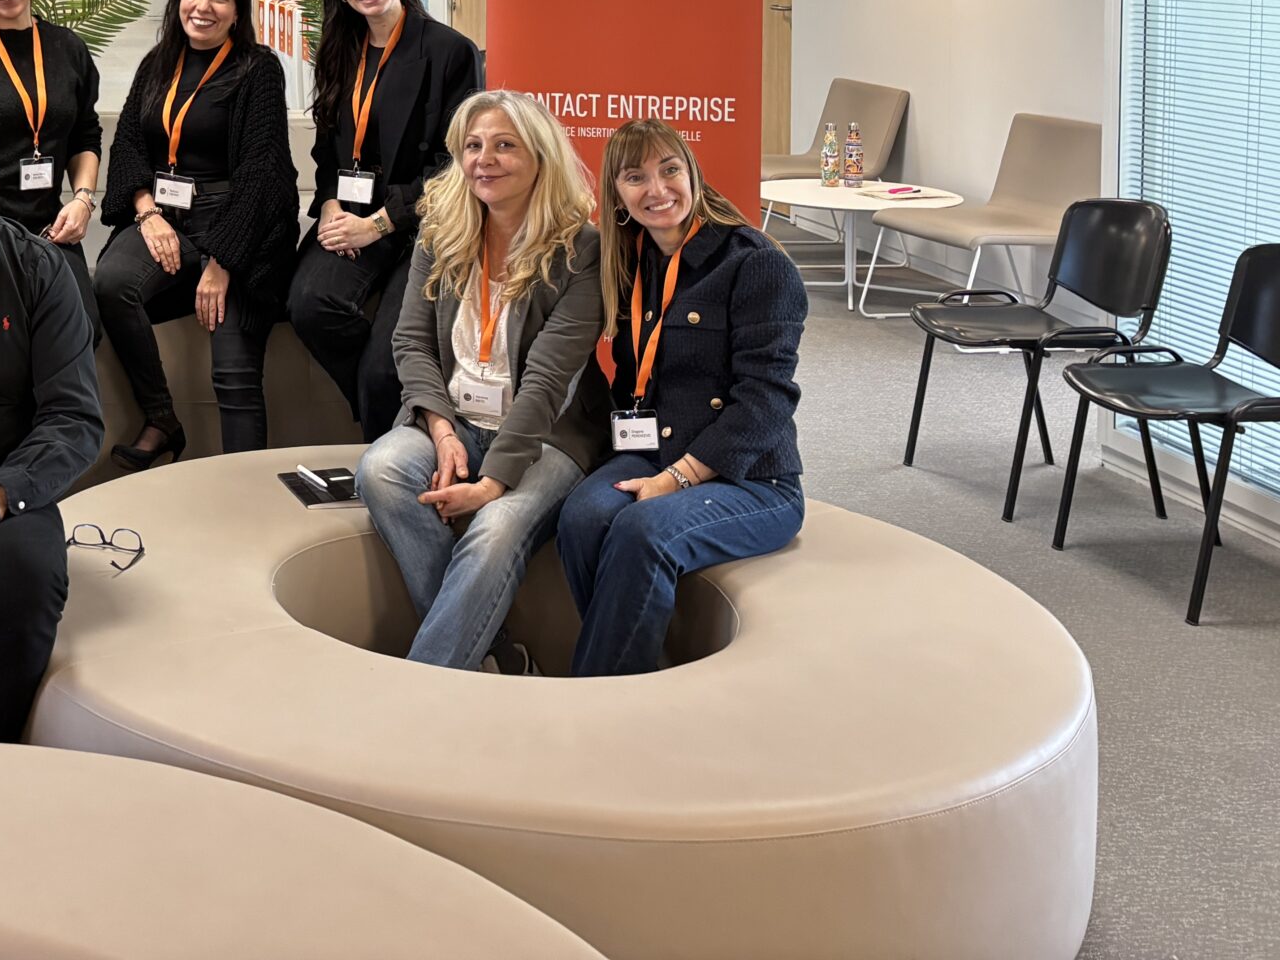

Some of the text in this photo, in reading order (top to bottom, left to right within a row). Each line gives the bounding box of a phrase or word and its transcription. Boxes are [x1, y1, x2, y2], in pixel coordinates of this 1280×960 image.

[524, 92, 736, 123] NTACT ENTREPRISE
[577, 126, 618, 138] INSERTIO
